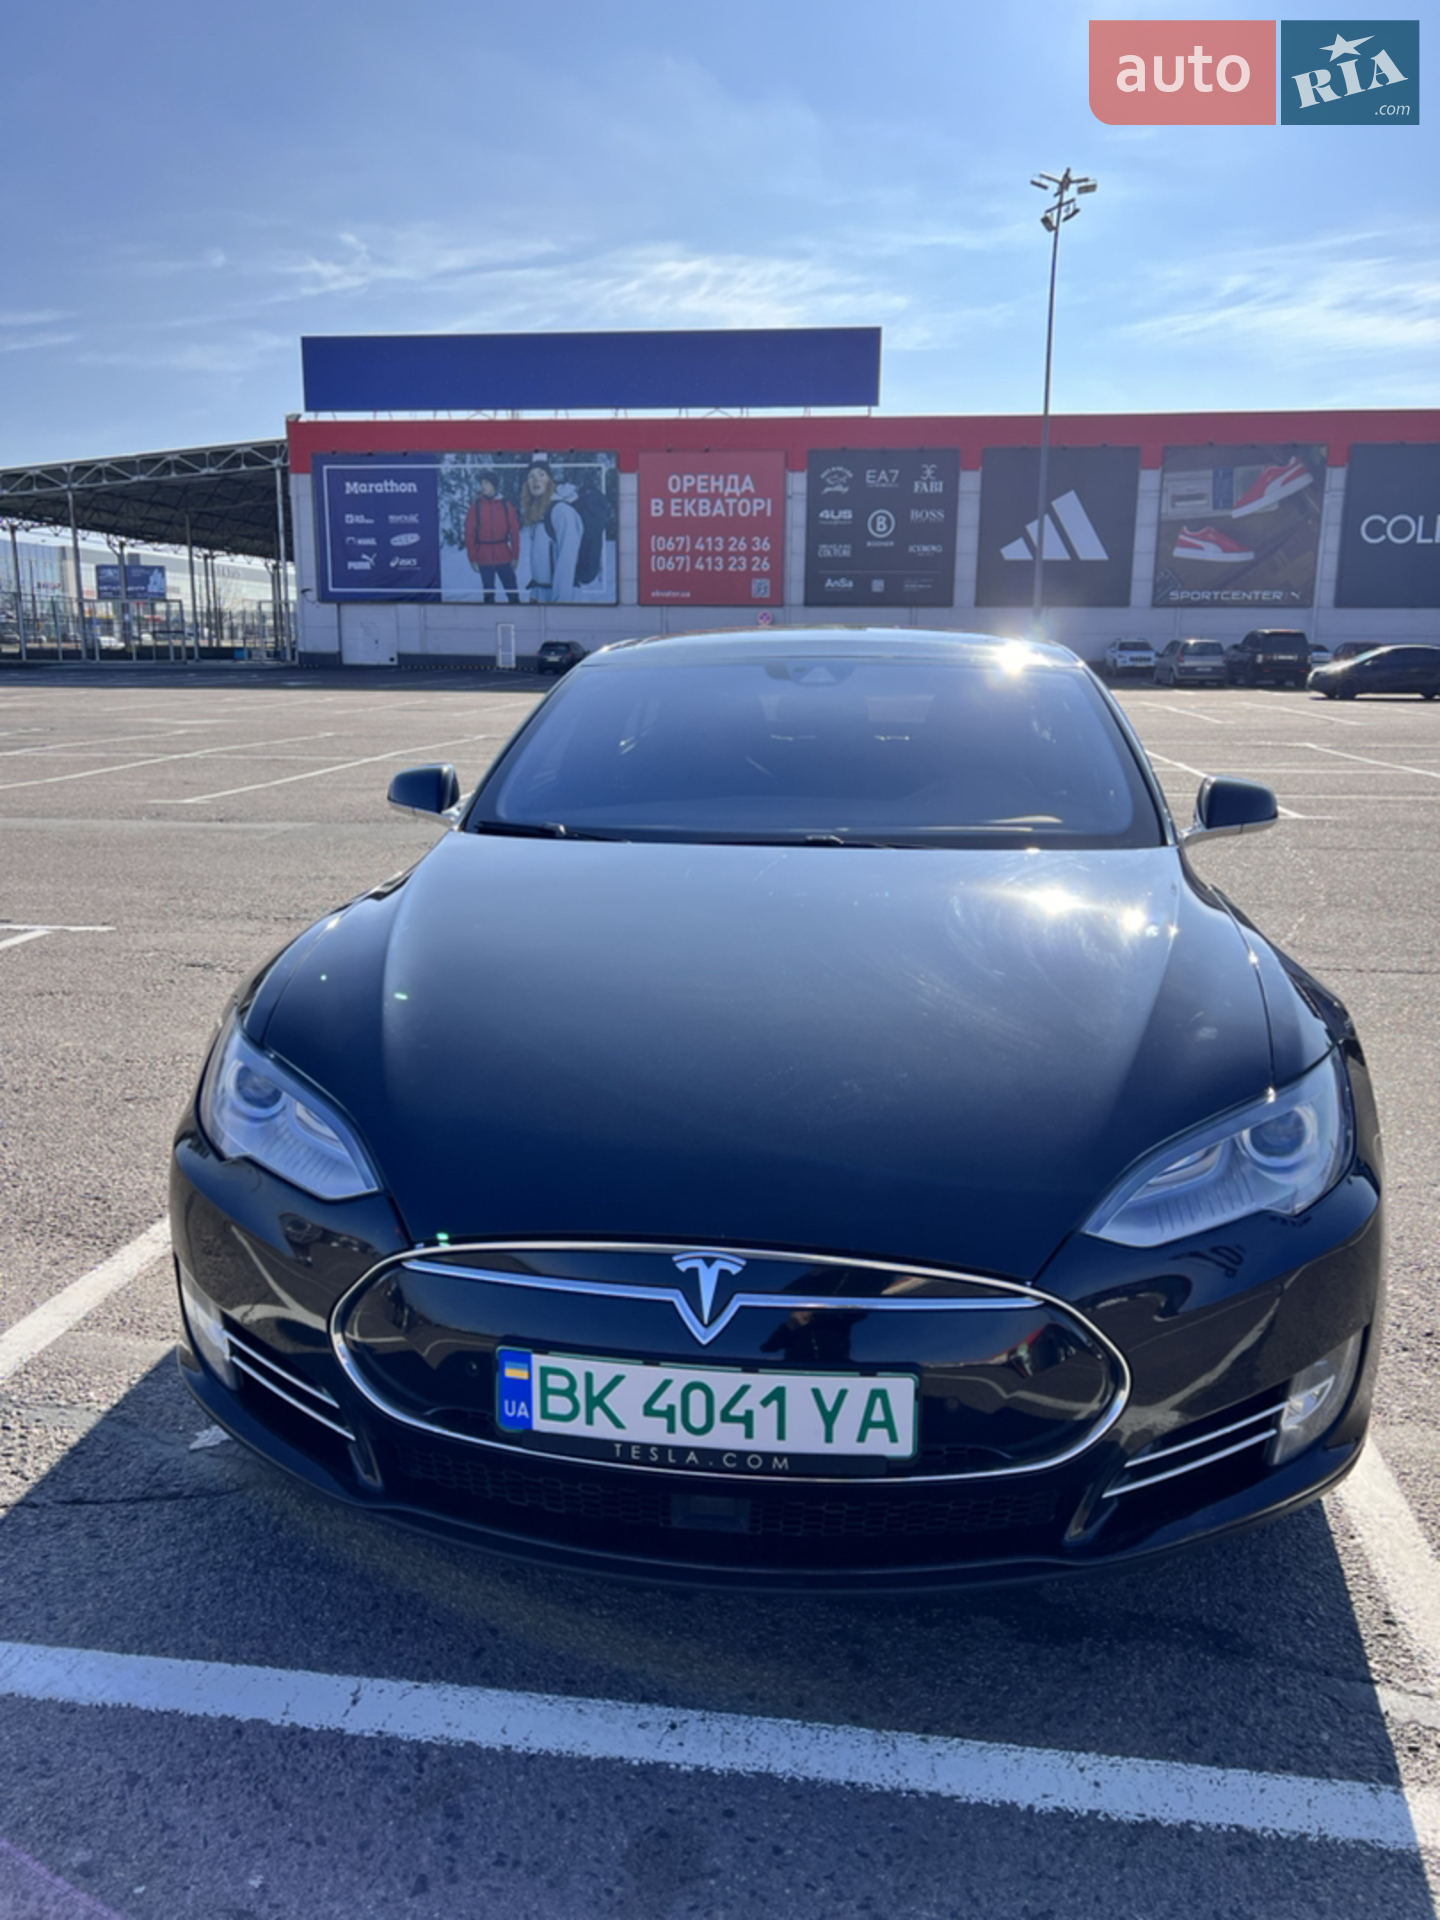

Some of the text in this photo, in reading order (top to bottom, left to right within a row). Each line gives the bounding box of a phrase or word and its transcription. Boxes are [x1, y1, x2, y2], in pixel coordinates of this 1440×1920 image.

[866, 469, 900, 483] EA7
[344, 480, 418, 494] Marathon
[667, 474, 755, 497] ОРЕНДА
[913, 480, 944, 493] FABI
[650, 498, 772, 517] В ЕКВАТОРІ
[910, 509, 945, 520] BOSS
[650, 535, 771, 552] (067) 413 26 36
[650, 555, 771, 573] (067) 413 23 26
[1169, 590, 1283, 601] SPORTCENTER
[503, 1398, 531, 1419] UA
[538, 1365, 900, 1444] BK 4041 YA
[613, 1443, 790, 1471] TESLA.COM
